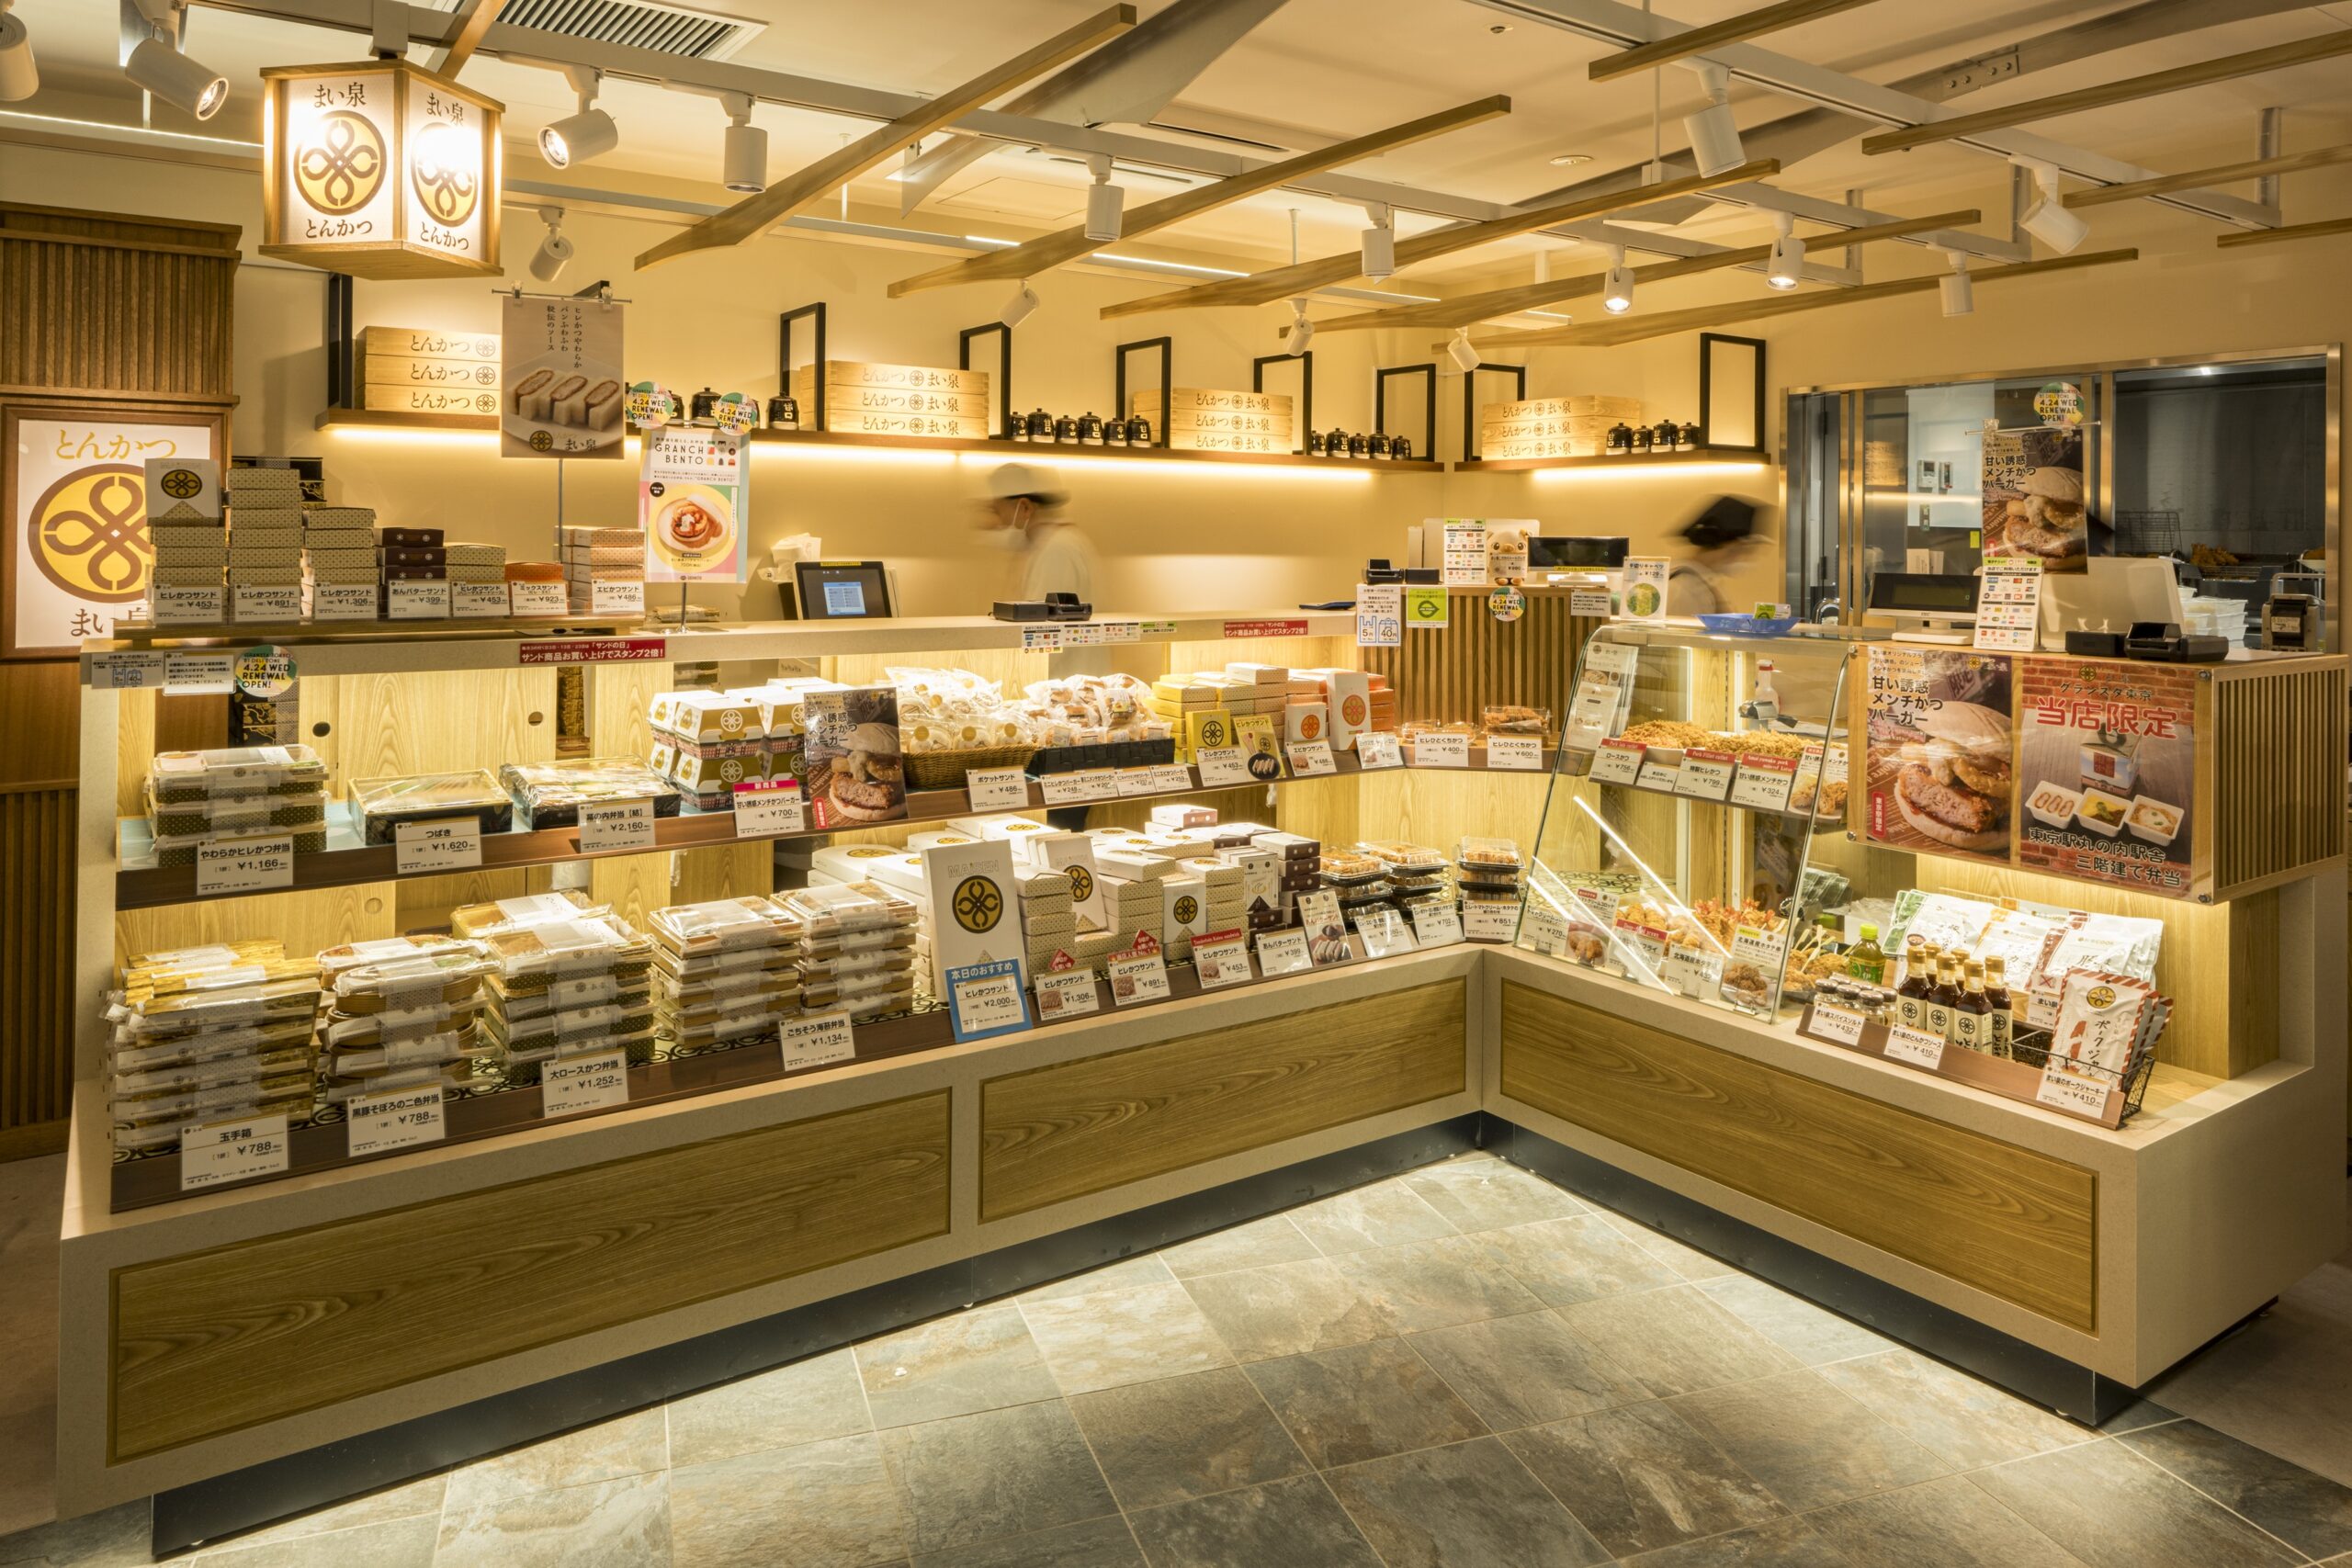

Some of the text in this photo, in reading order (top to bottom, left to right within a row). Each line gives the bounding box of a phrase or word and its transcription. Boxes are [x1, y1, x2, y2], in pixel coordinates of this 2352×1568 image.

[313, 82, 366, 107] まい泉
[426, 93, 464, 126] まい泉
[305, 219, 373, 239] とんかつ
[420, 221, 469, 250] とんかつ
[411, 334, 469, 352] とんかつ
[411, 363, 469, 380] とんかつ
[862, 367, 959, 388] とんかつ まい泉
[411, 392, 469, 410] とんかつ
[862, 392, 959, 412] とんかつ まい泉
[1196, 393, 1270, 410] とんかつ まい泉
[632, 406, 663, 414] RENEWAL
[738, 411, 752, 419] WED
[1502, 401, 1571, 418] とんかつ まい泉
[718, 414, 749, 425] RENEWAL
[862, 416, 959, 436] とんかつ まい泉
[1196, 413, 1270, 430] とんかつ まい泉
[1502, 421, 1571, 437] とんかつ まい泉
[55, 429, 177, 459] とんかつ
[566, 438, 597, 451] まい泉
[655, 444, 704, 454] GRANCH
[1196, 434, 1270, 451] とんかつ まい泉
[1502, 440, 1571, 457] とんかつ まい泉
[665, 455, 704, 465] BENTO
[1985, 455, 2026, 466] 甘い誘惑
[1985, 467, 2037, 478] メンチかつ
[1984, 478, 2026, 490] バーガー
[70, 607, 148, 637] まい
[1872, 675, 1928, 694] 甘い誘惑
[2060, 682, 2152, 702] グランスタ東京
[1871, 693, 1943, 712] メンチかつ
[1237, 719, 1269, 728] ヒレかつサンド
[1871, 709, 1928, 725] バーガー
[2036, 696, 2177, 740] 当店限定
[1606, 753, 1630, 761] ロースかつ
[1690, 765, 1721, 776] 特製ヒレかつ
[978, 774, 1014, 783] ポケットサンド
[1738, 773, 1789, 785] 甘い誘惑メンチかつ
[754, 782, 778, 790] 新商品
[1761, 787, 1780, 795] ¥324
[737, 796, 800, 807] 甘い誘惑メンチかつバーガー
[610, 821, 643, 831] ¥2,160
[425, 828, 451, 839] つばき
[200, 842, 290, 859] やわらかヒレかつ弁当
[432, 840, 469, 852] ¥1,620
[2029, 827, 2165, 863] 東京駅丸の内駅舎
[237, 859, 278, 870] ¥1,166
[2076, 854, 2181, 886] 三階建て弁当
[1547, 928, 1563, 936] ¥270
[1262, 937, 1302, 950] あんバターサンド
[1203, 947, 1238, 959] ヒレかつサンド
[951, 962, 1012, 980] 本日のおすすめ
[1118, 961, 1156, 976] ヒレかつサンド
[1227, 963, 1243, 971] ¥453
[1045, 975, 1085, 988] ヒレかつサンド
[1142, 978, 1160, 987] ¥891
[965, 984, 1009, 998] ヒレかつサンド
[1065, 992, 1090, 1003] ¥1,306
[984, 998, 1011, 1008] ¥2,000
[1815, 1010, 1862, 1026] まい泉スパイスソルト
[786, 1020, 845, 1037] ごちそう海苔弁当
[1836, 1024, 1854, 1033] ¥432
[810, 1033, 842, 1046] ¥1,134
[1892, 1029, 1942, 1049] まい泉のとんかつソース
[1913, 1045, 1934, 1055] ¥410
[550, 1059, 618, 1078] 大ロースかつ弁当
[577, 1076, 615, 1089] ¥1,252
[2046, 1074, 2105, 1096] まい泉のポークジャーキー
[2073, 1091, 2096, 1104] ¥410
[352, 1093, 439, 1118] 黒豚そぼろの二色弁当
[398, 1111, 430, 1124] ¥788
[220, 1128, 252, 1143] 玉手箱
[236, 1142, 272, 1156] ¥788
